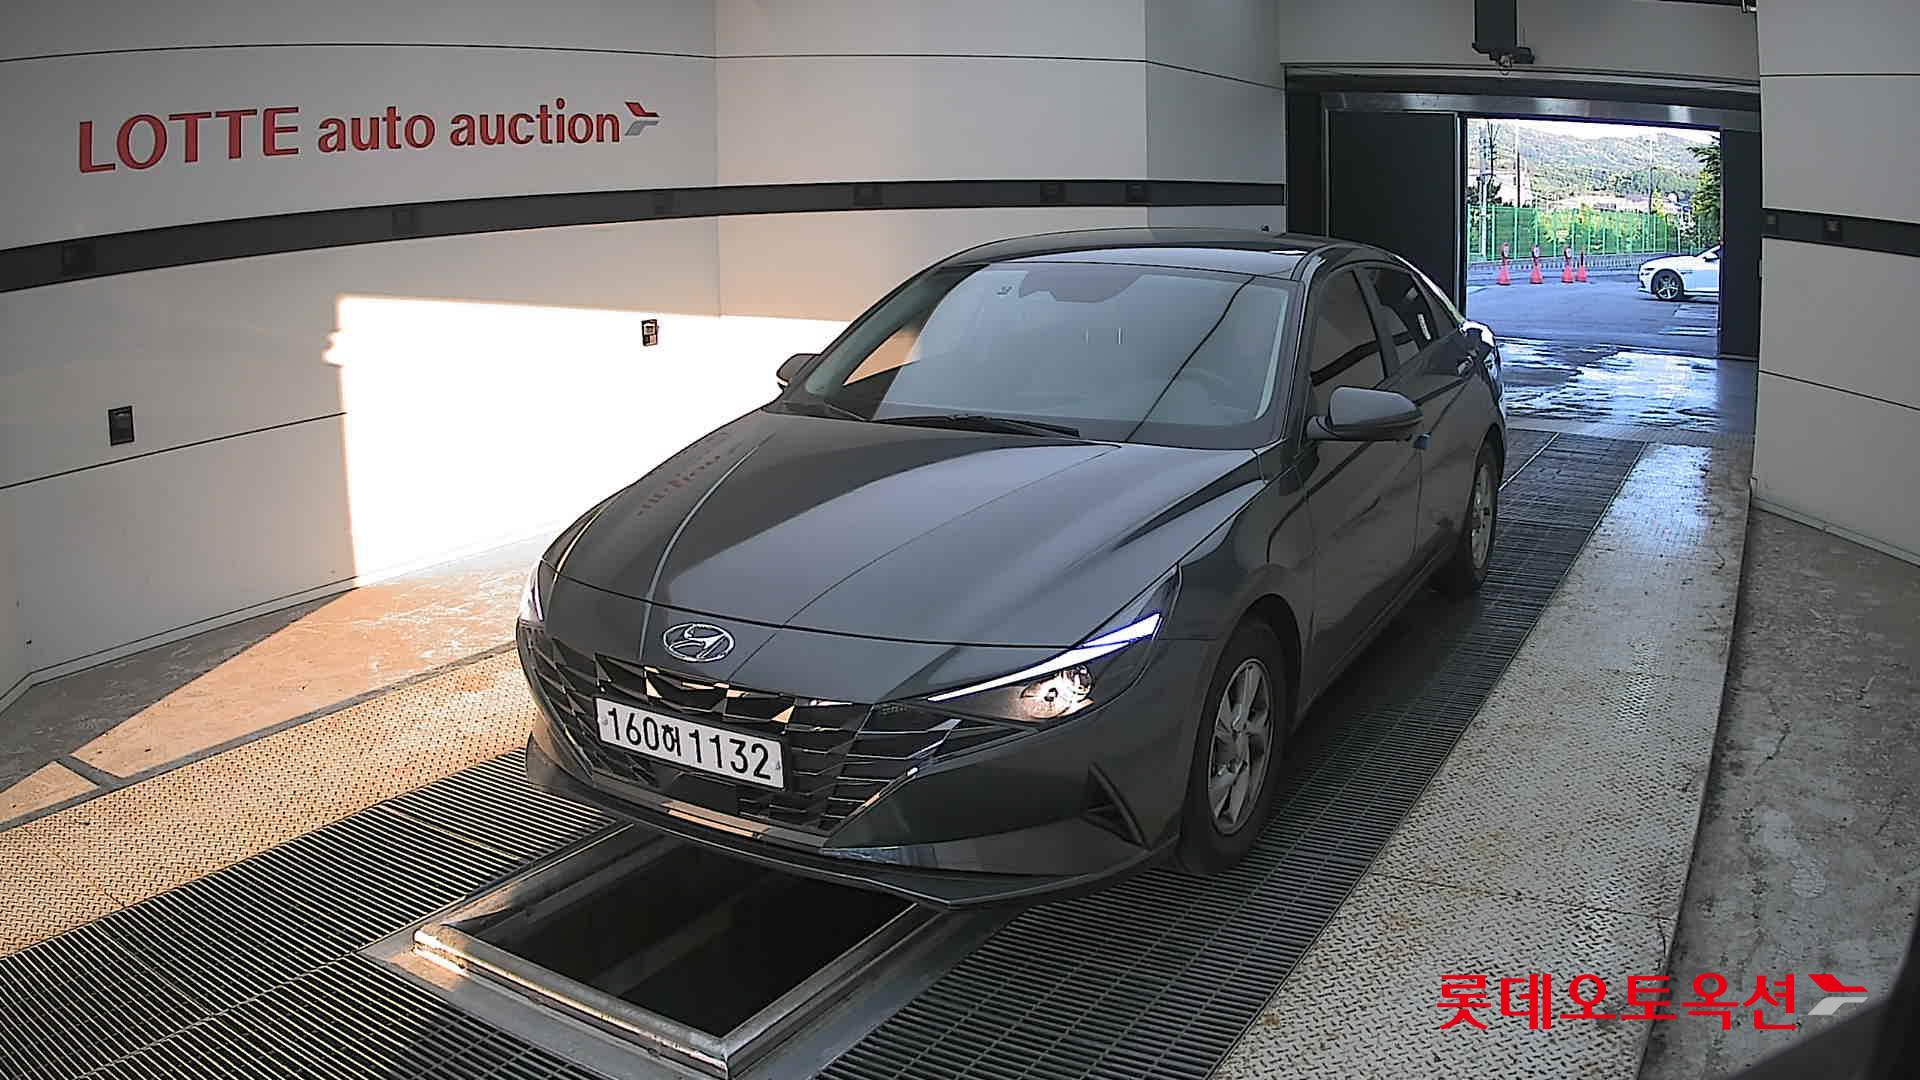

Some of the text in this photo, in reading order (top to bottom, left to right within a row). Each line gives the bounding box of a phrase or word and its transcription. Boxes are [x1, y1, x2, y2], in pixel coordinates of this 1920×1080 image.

[79, 99, 622, 173] LOTTE auto auction
